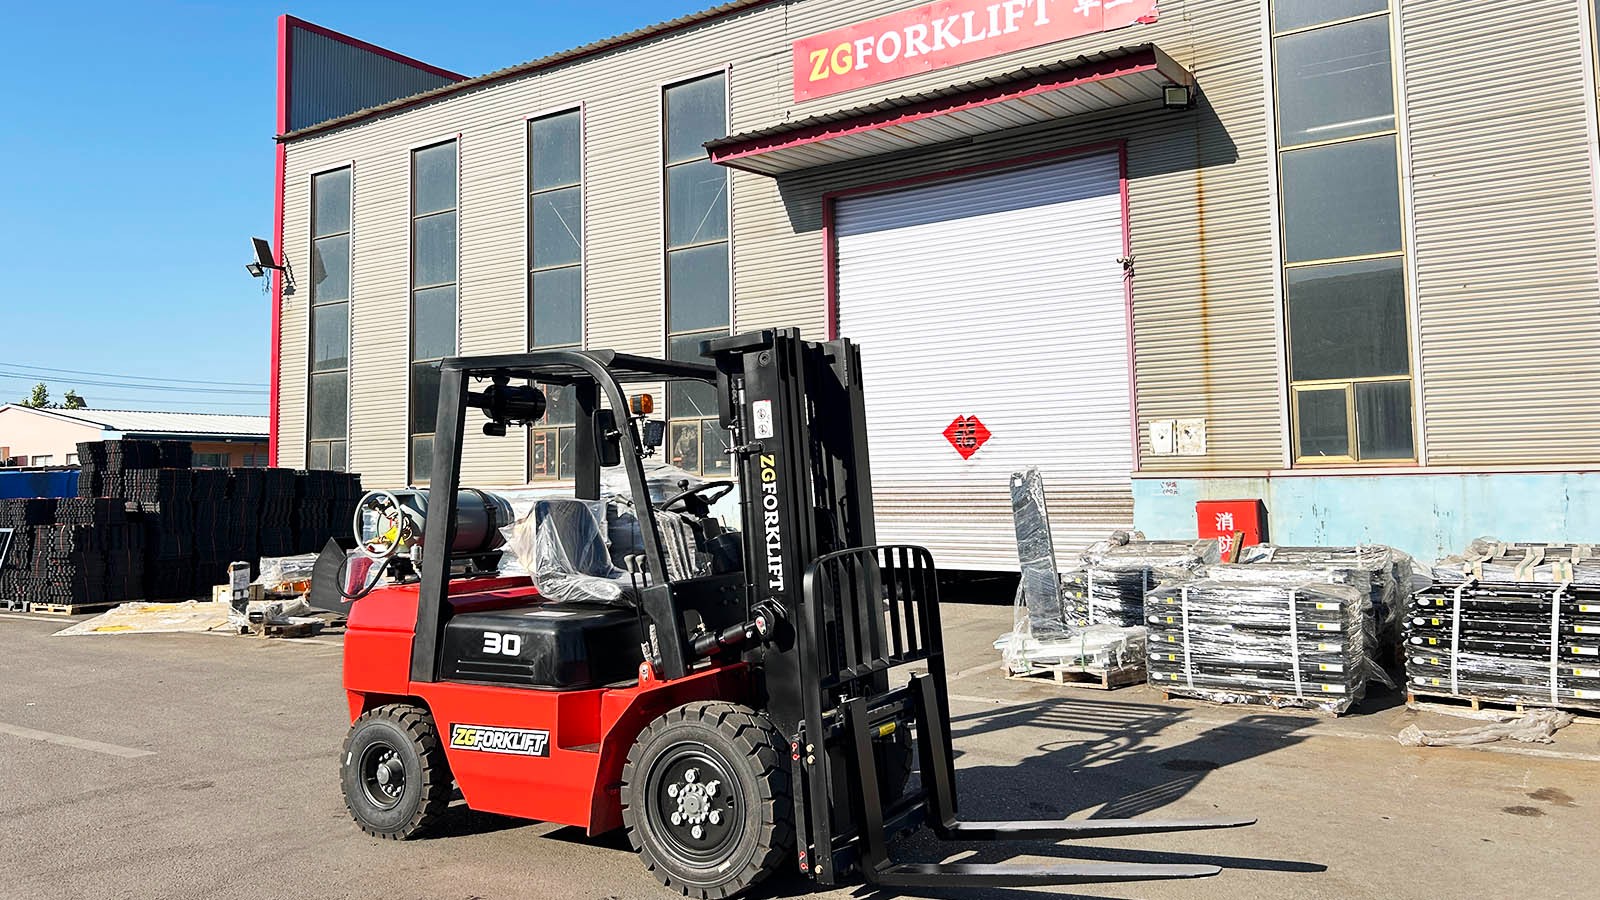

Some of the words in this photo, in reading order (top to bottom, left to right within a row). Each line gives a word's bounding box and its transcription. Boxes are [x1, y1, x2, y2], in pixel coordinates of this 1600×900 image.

[809, 0, 1054, 82] ZGFORKLIFT
[760, 454, 785, 591] ZGFORKLIFT
[1215, 511, 1234, 554] 消防
[482, 631, 521, 656] 30
[453, 727, 546, 752] ZGFORKLIFT
